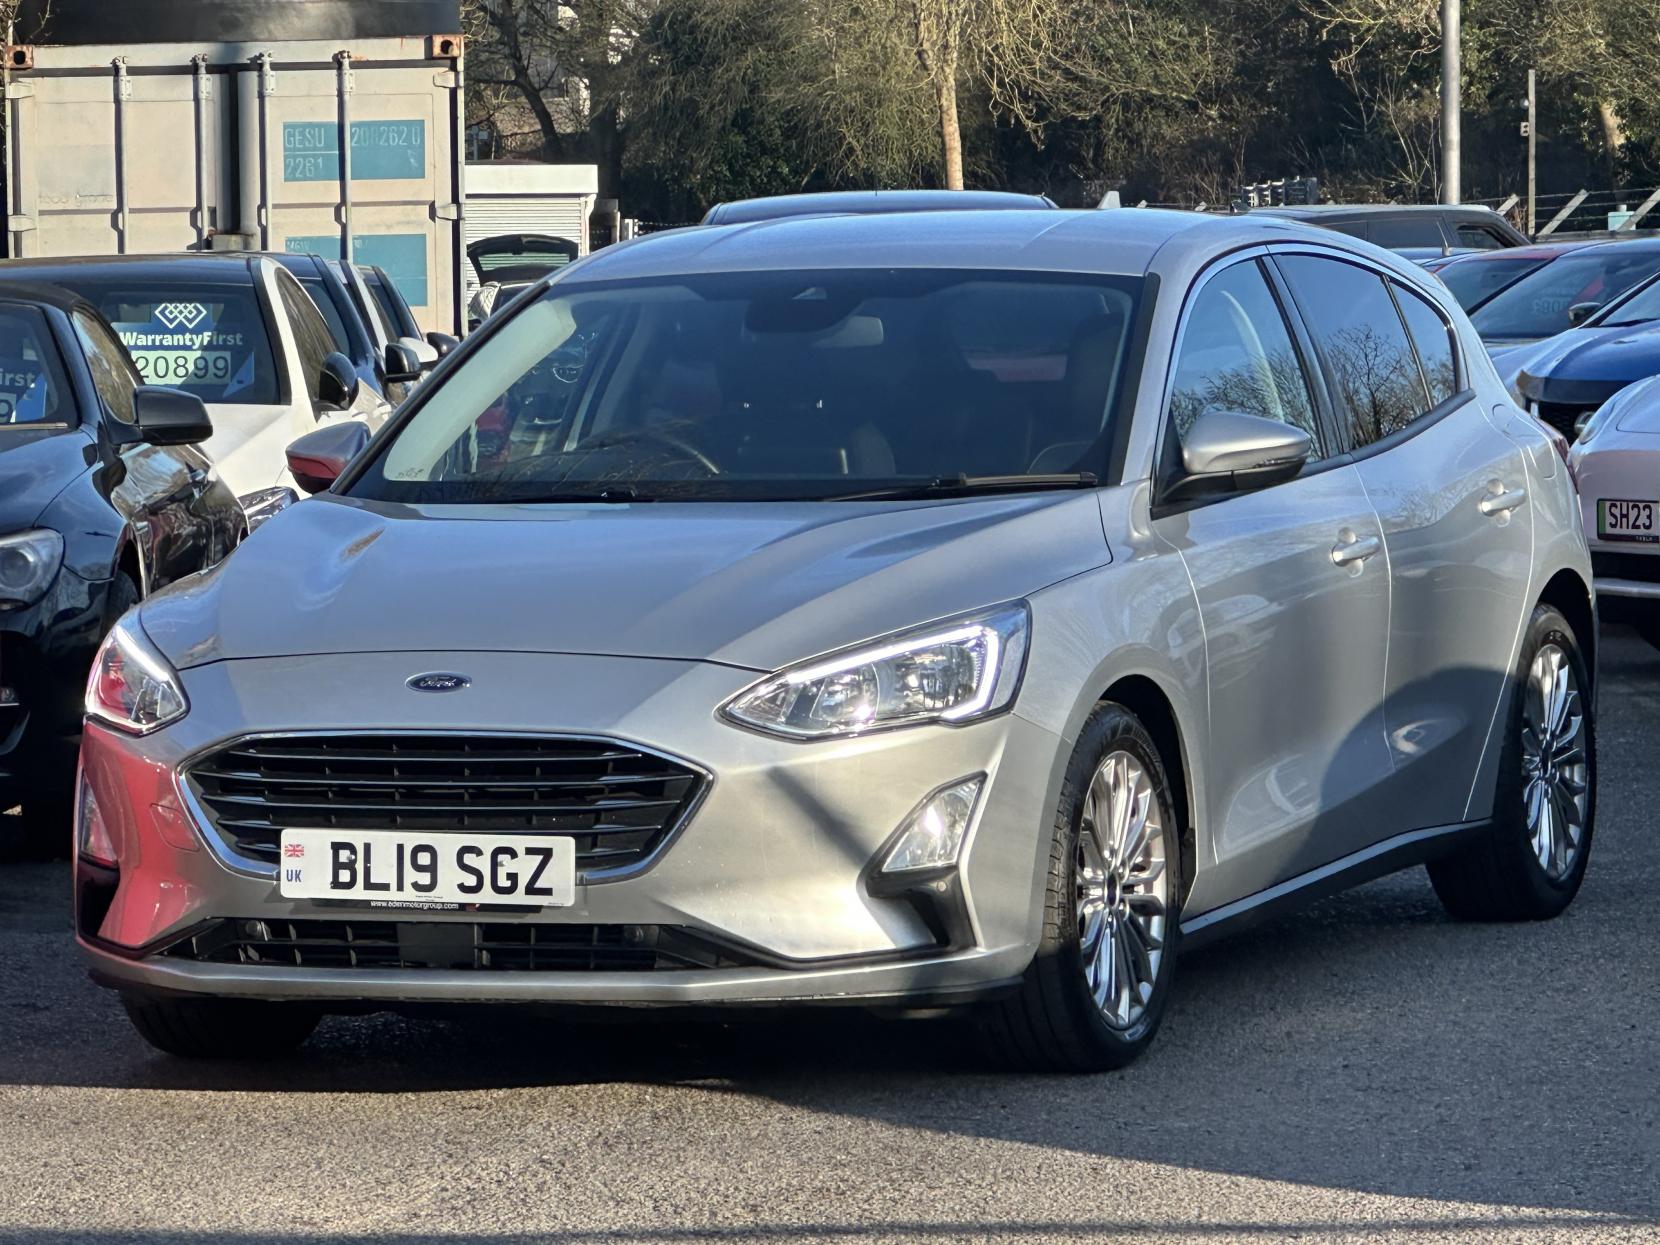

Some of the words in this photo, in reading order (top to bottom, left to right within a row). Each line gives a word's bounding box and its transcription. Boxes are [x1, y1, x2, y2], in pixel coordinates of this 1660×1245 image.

[284, 127, 324, 148] GESU
[119, 331, 243, 349] WarrantyFirst
[134, 355, 229, 379] 20899
[1608, 502, 1653, 530] SH23
[286, 869, 302, 883] UK
[330, 841, 438, 893] BL19
[455, 845, 554, 896] SGZ
